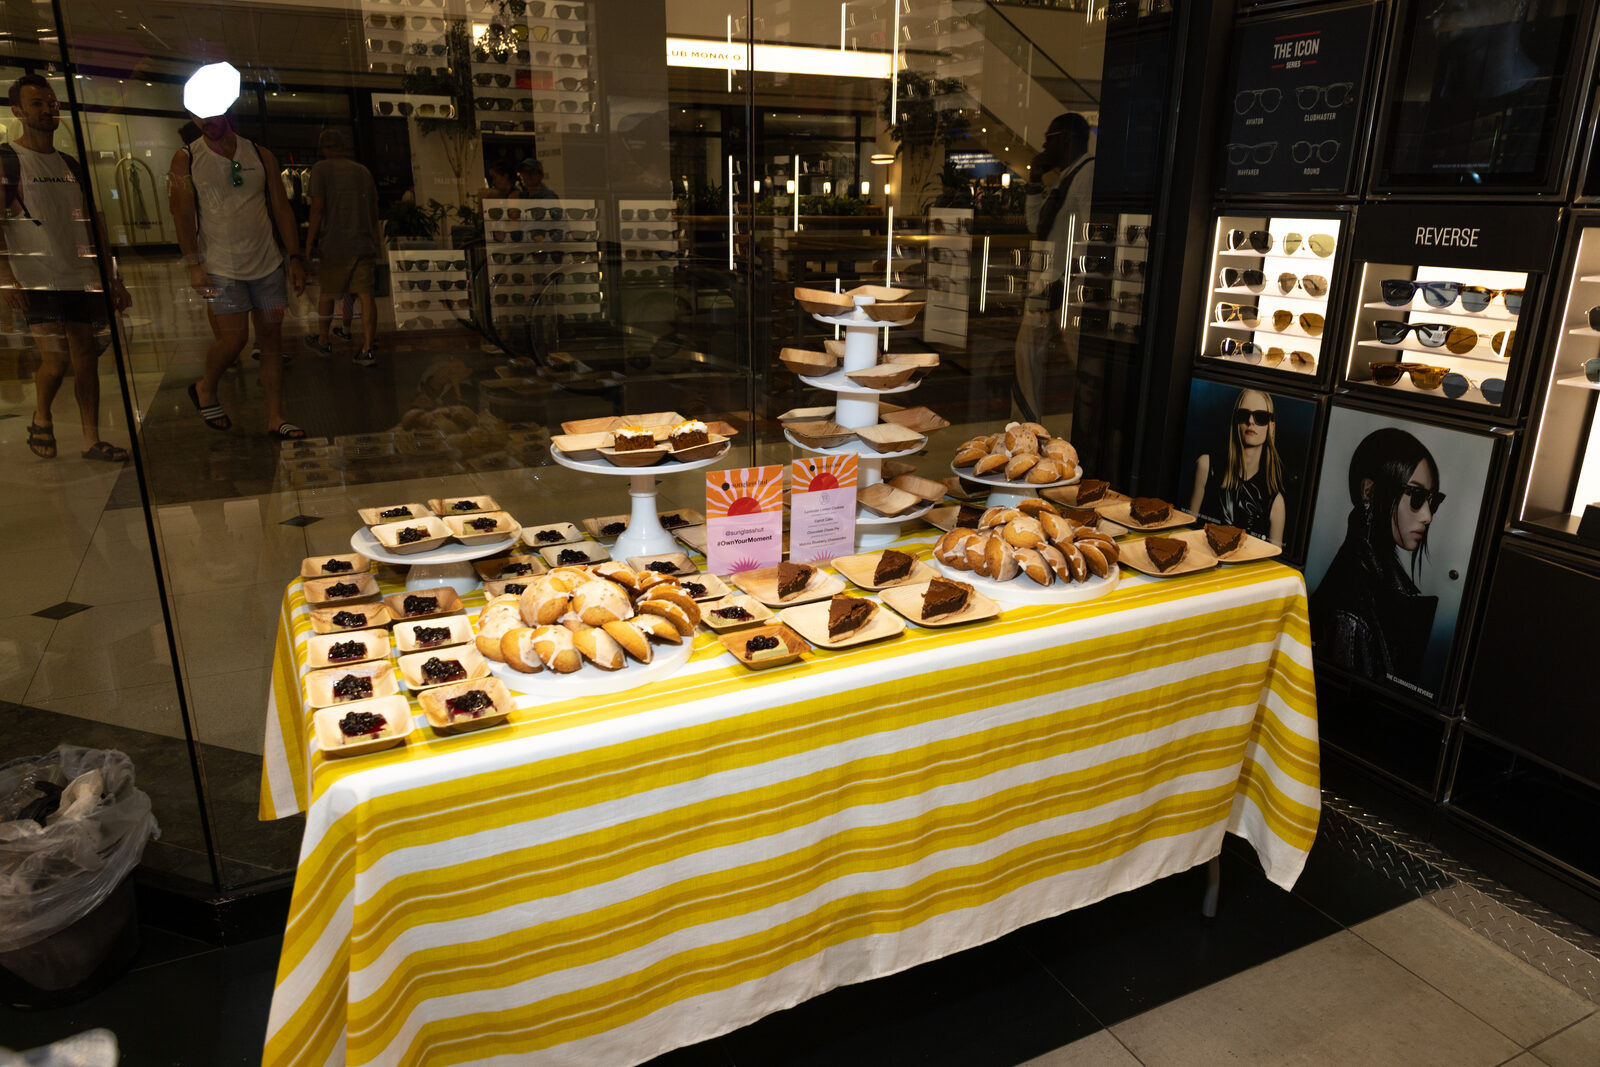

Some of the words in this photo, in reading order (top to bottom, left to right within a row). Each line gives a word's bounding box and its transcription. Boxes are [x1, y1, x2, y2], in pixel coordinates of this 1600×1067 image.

[1273, 42, 1292, 60] THE
[1294, 39, 1320, 57] ICON
[1285, 60, 1301, 69] SERIES
[1245, 117, 1264, 126] AVIATOR
[1303, 112, 1337, 122] CLUBMASTER
[1303, 167, 1320, 175] ROUND
[1415, 226, 1481, 248] REVERSE
[725, 527, 765, 537] @sunglasshut
[717, 535, 773, 547] #OwnYourMoment
[1393, 676, 1418, 692] CLUBMASTER
[1417, 687, 1434, 699] REVERSE
